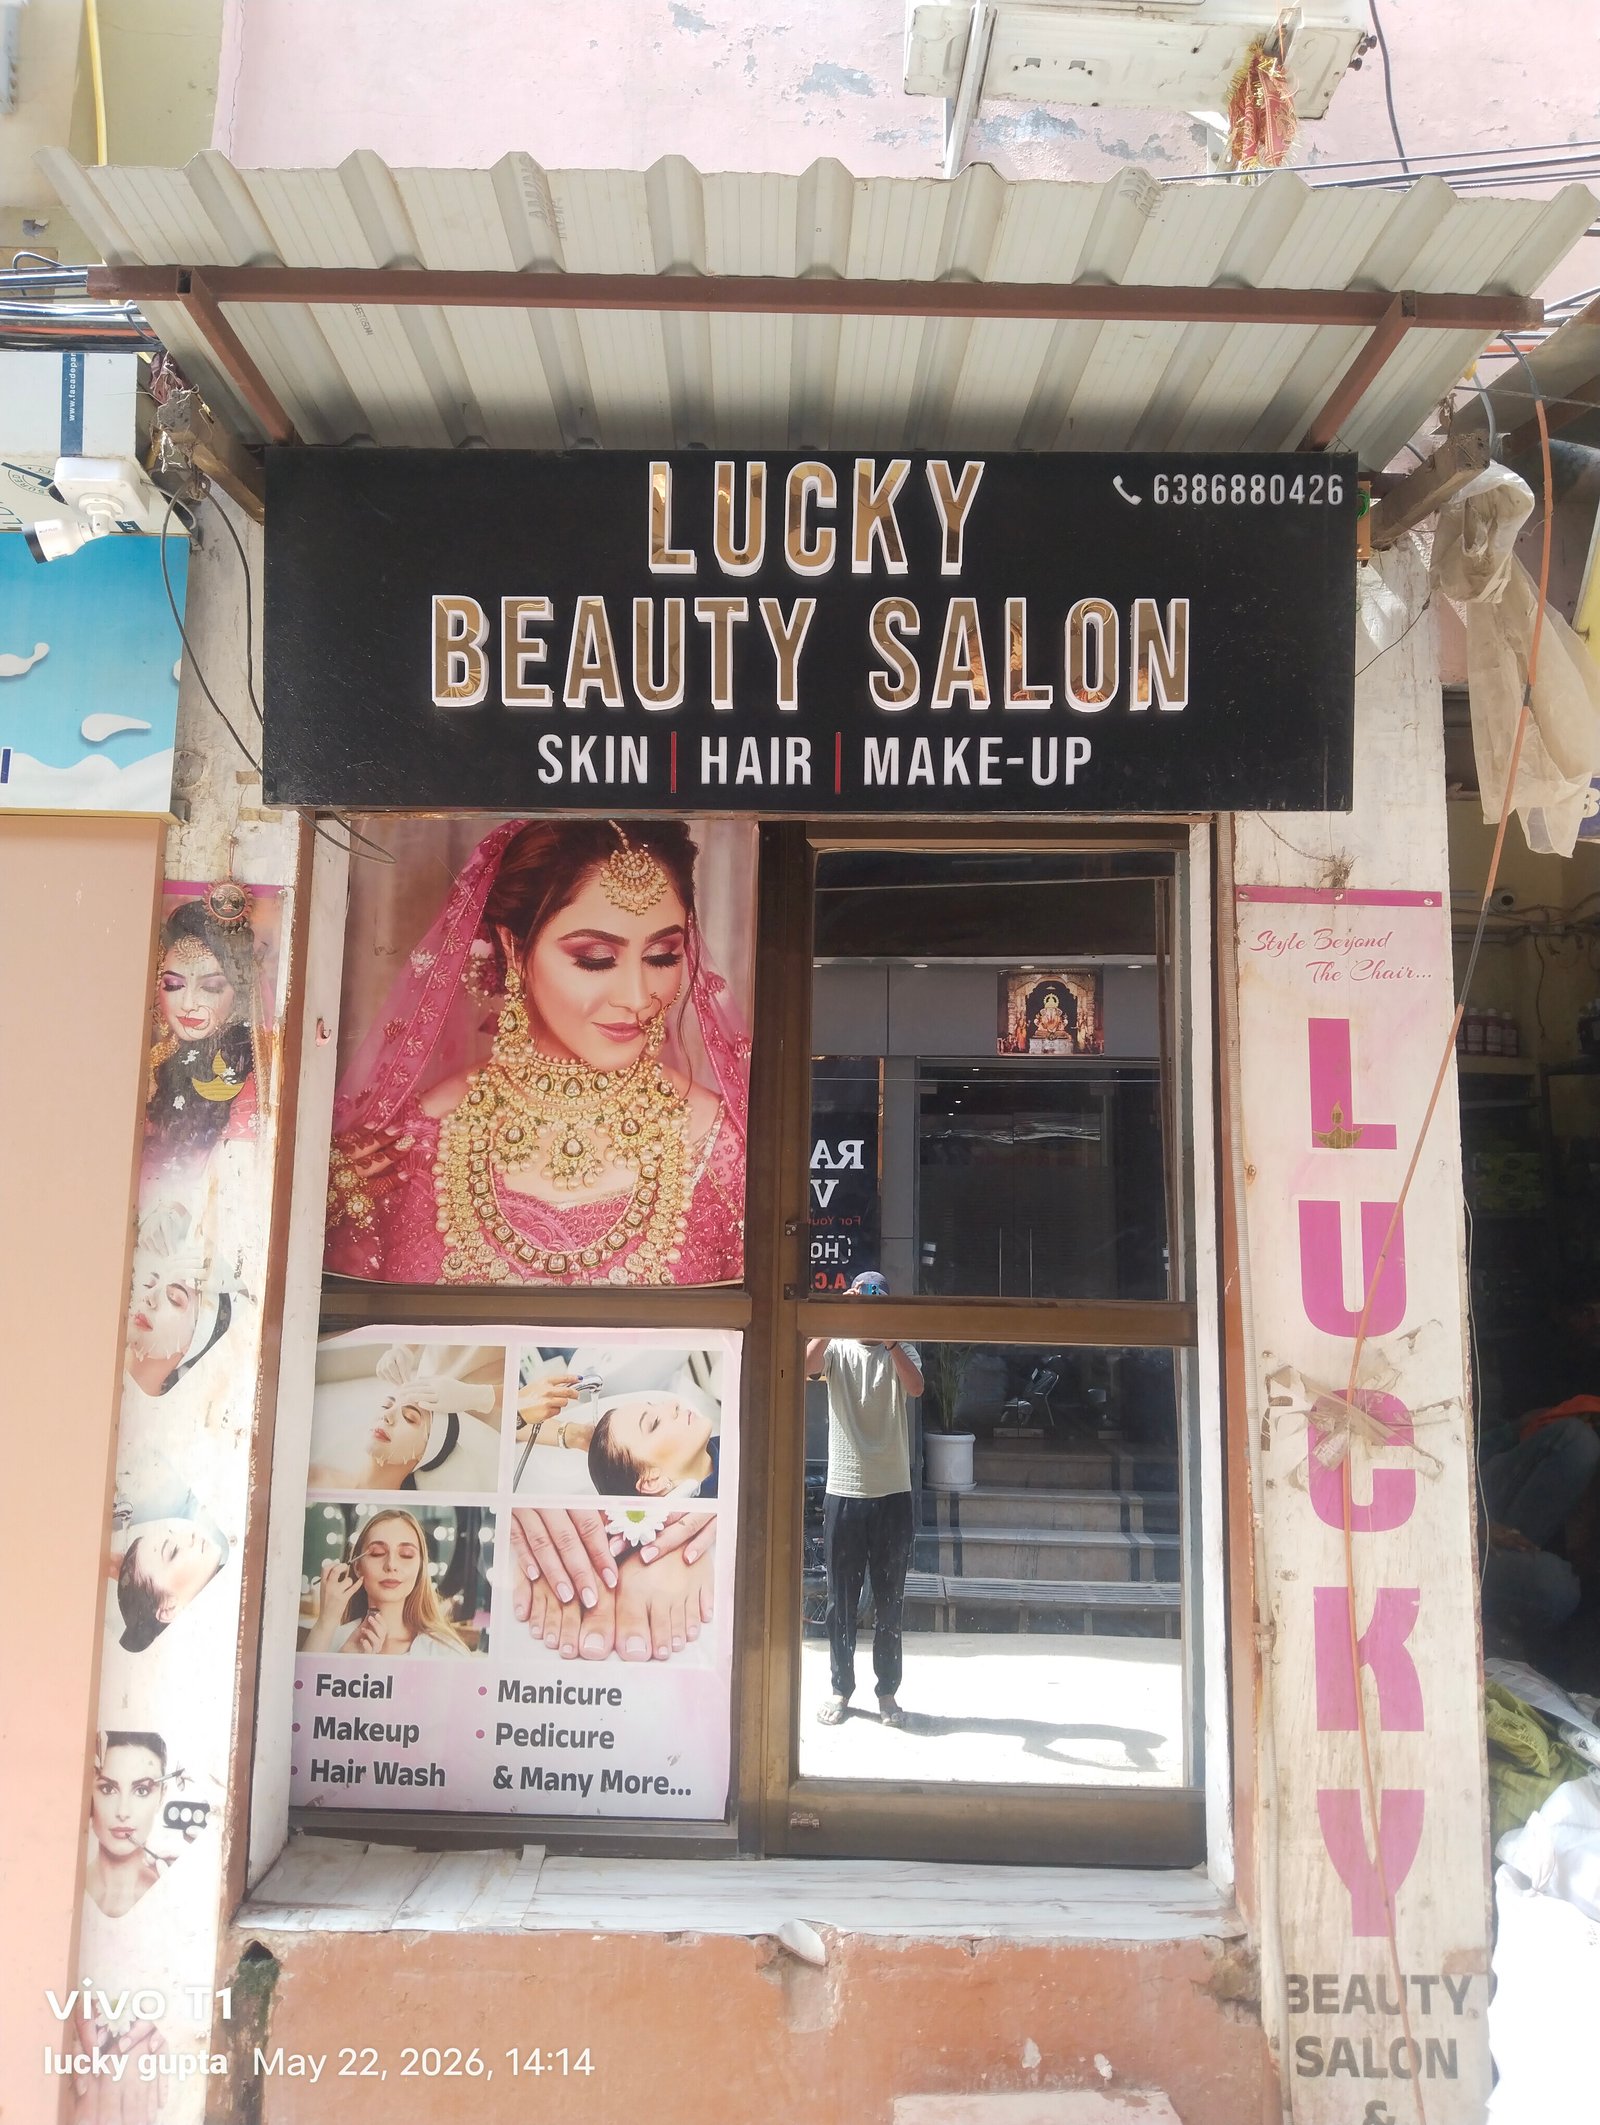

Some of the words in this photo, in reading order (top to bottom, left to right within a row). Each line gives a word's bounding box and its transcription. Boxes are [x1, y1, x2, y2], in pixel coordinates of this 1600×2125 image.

[1152, 473, 1344, 506] 6386880426
[648, 459, 985, 577] LUCKY
[430, 594, 817, 712] BEAUTY
[868, 597, 1190, 712] SALON
[537, 734, 648, 786] SKIN
[700, 736, 812, 786] HAIR
[863, 737, 1093, 787] MAKE-UP
[1250, 930, 1308, 957] Style
[1312, 927, 1394, 957] Beyond
[1305, 961, 1343, 984] The
[1297, 1017, 1426, 1937] LUCKY
[315, 1673, 394, 1700] Facial
[497, 1680, 623, 1707] Manicure
[312, 1716, 420, 1748] Makeup
[495, 1722, 616, 1750] Pedicure
[309, 1759, 366, 1788] Hair
[373, 1762, 446, 1787] Wash
[492, 1765, 514, 1790] &
[520, 1767, 593, 1797] Many
[1286, 1974, 1472, 2016] BEAUTY
[1295, 2036, 1459, 2080] SALON
